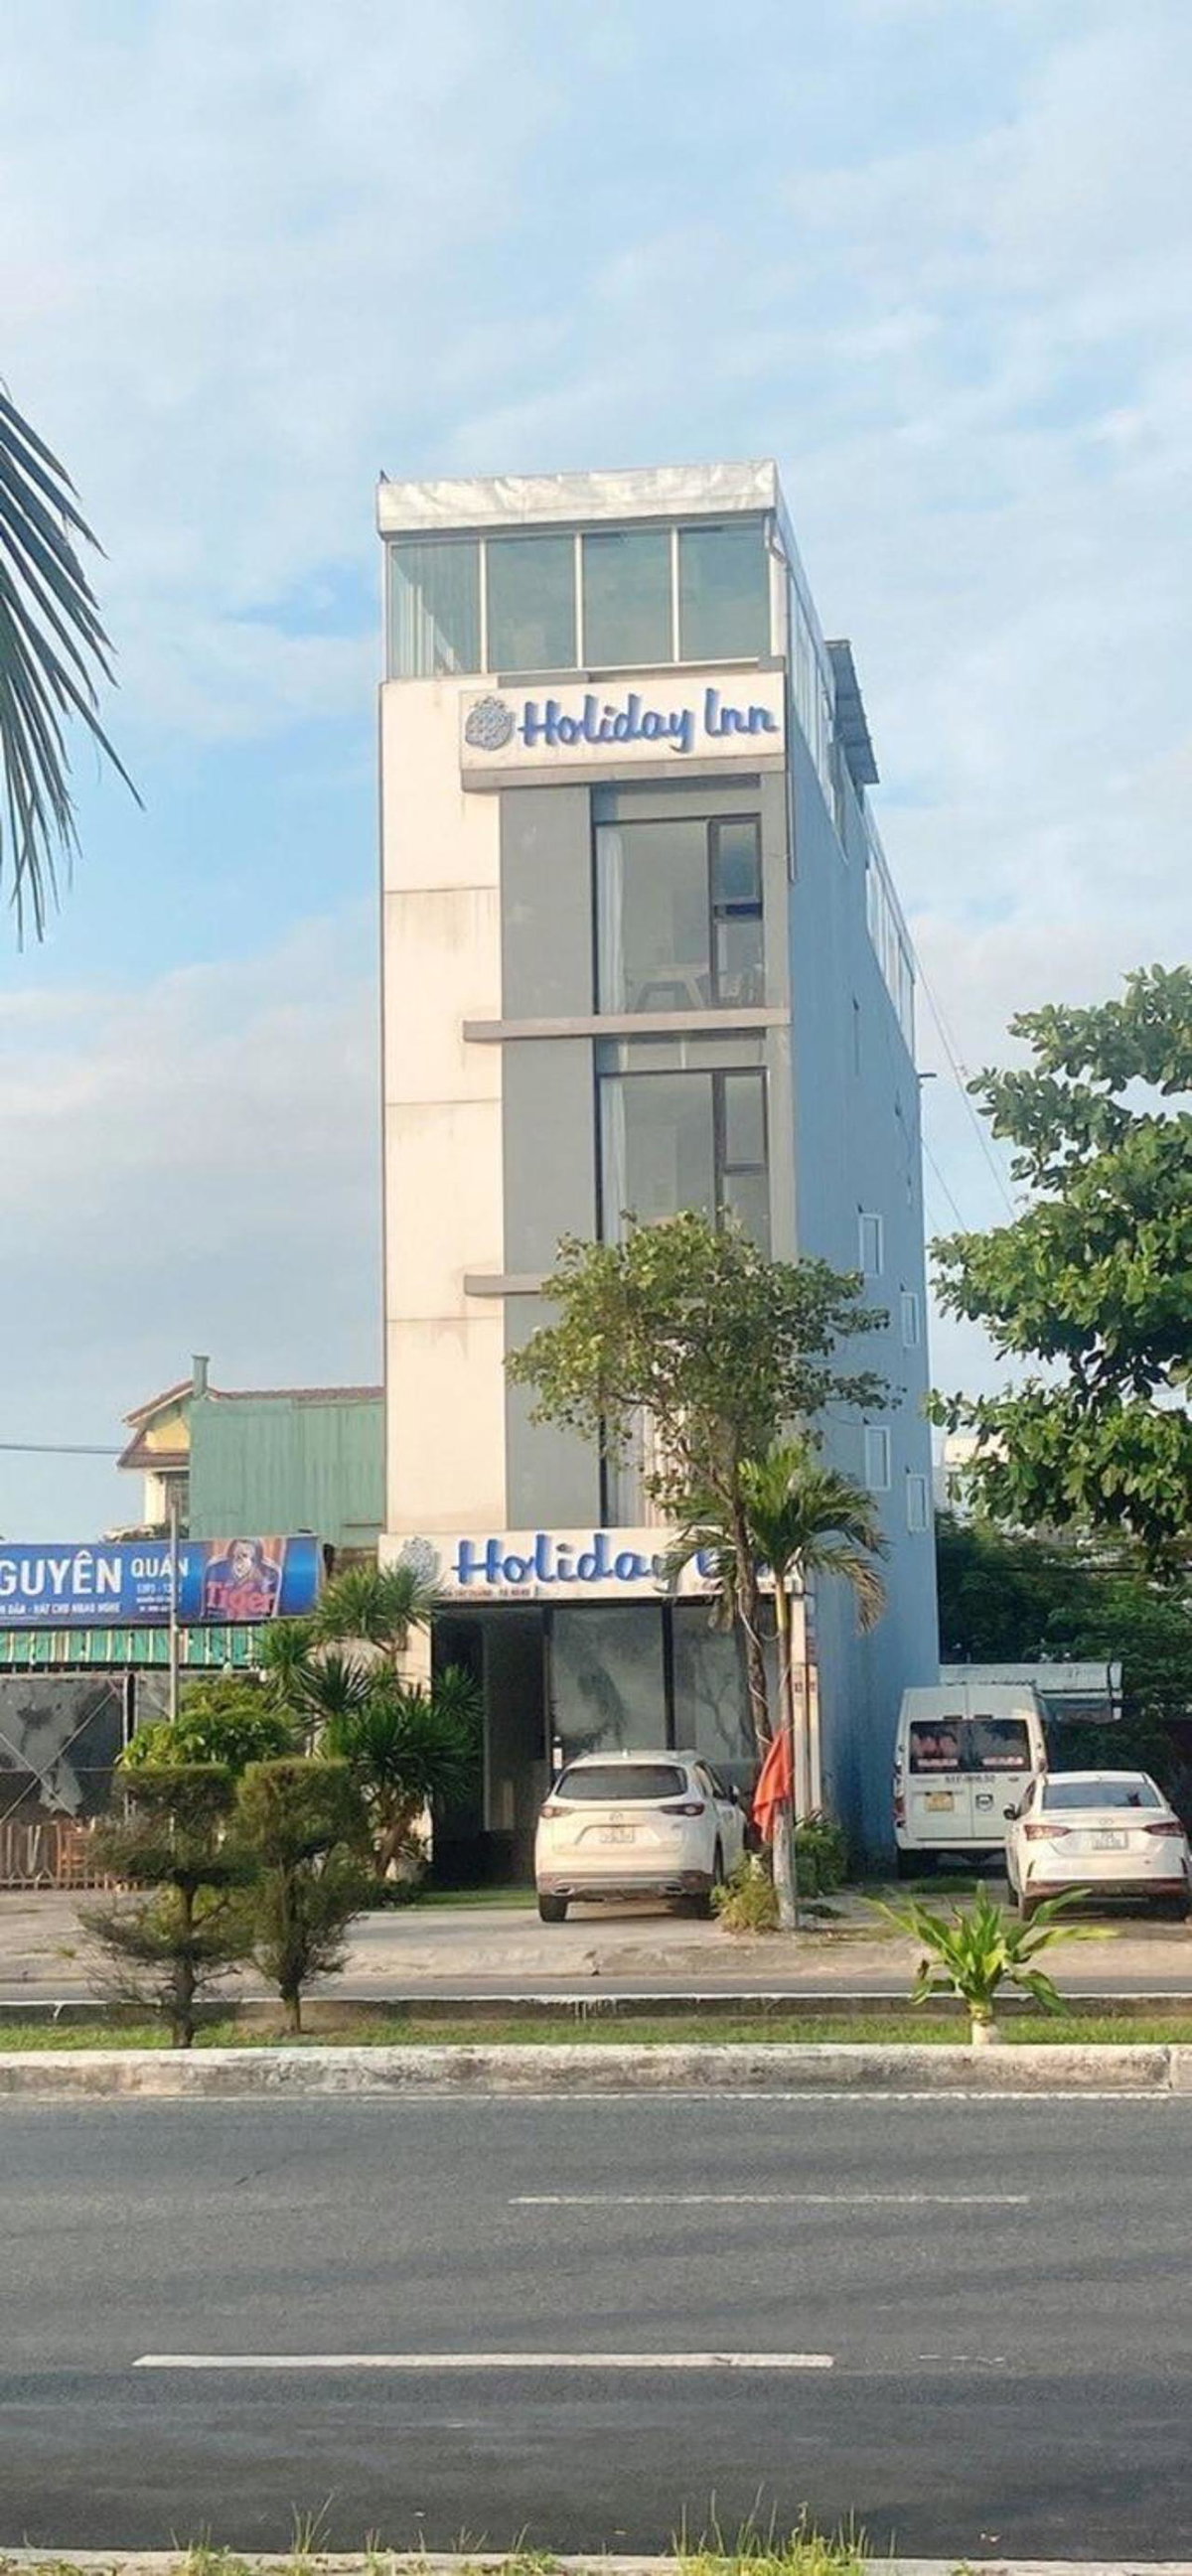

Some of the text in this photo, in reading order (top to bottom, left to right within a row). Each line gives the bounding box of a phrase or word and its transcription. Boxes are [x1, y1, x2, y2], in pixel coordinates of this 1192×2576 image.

[519, 687, 779, 753] Holiday Inn
[0, 1549, 121, 1596] GUYÊN
[207, 1581, 276, 1620] Tiger
